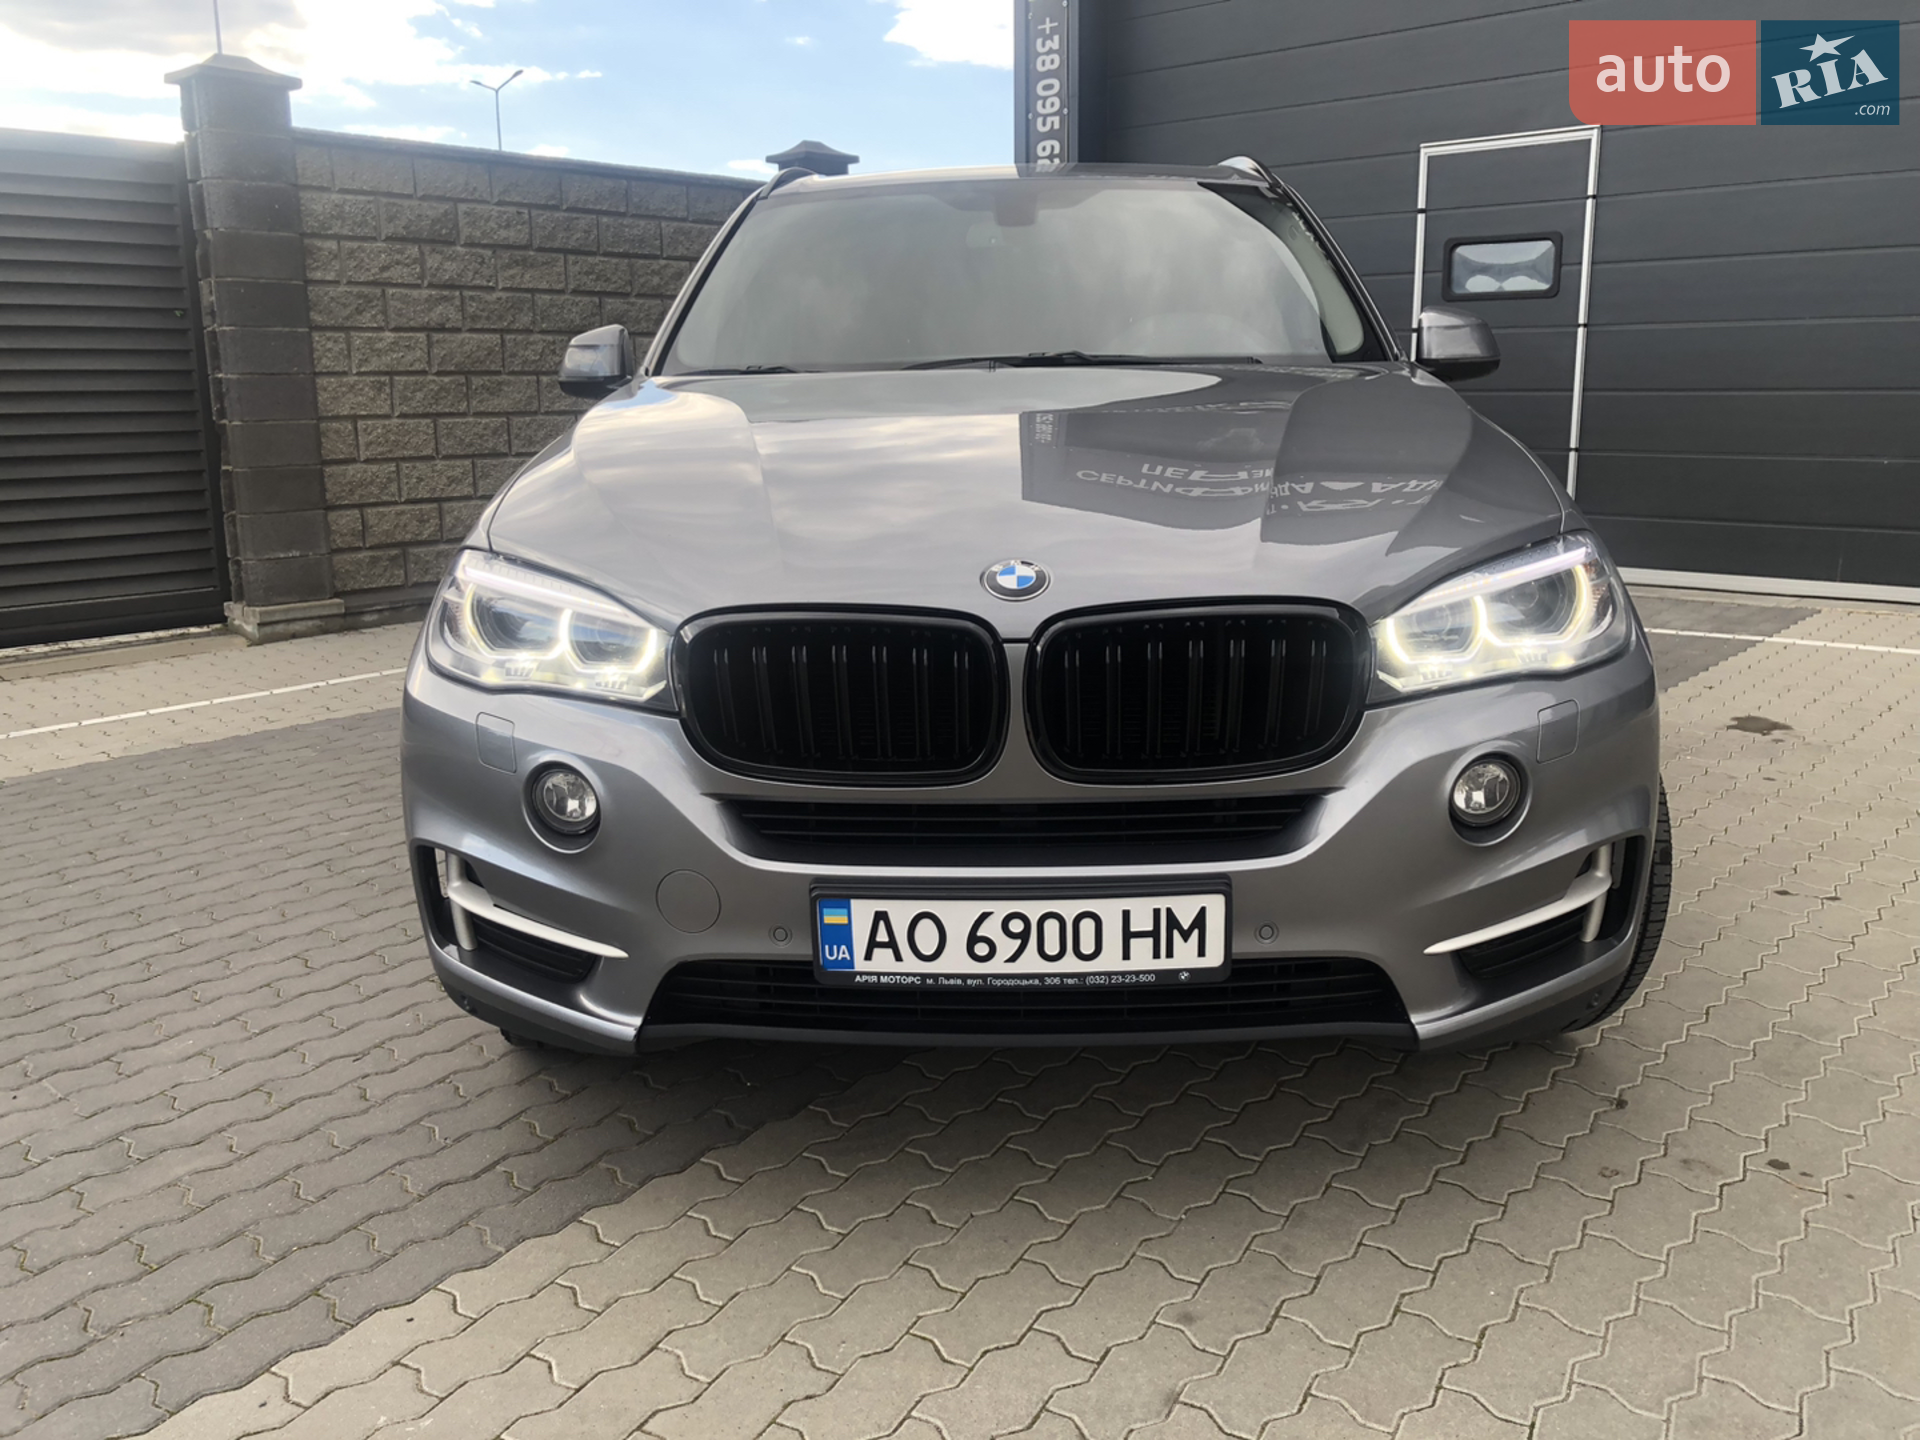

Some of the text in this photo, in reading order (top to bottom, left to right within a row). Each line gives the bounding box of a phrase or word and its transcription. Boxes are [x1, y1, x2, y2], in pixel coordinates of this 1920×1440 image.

[1036, 78, 1061, 133] 095
[825, 944, 850, 961] UA
[966, 909, 1103, 964] 6900
[1085, 974, 1109, 986] (032)
[1110, 973, 1156, 984] 23-23-500
